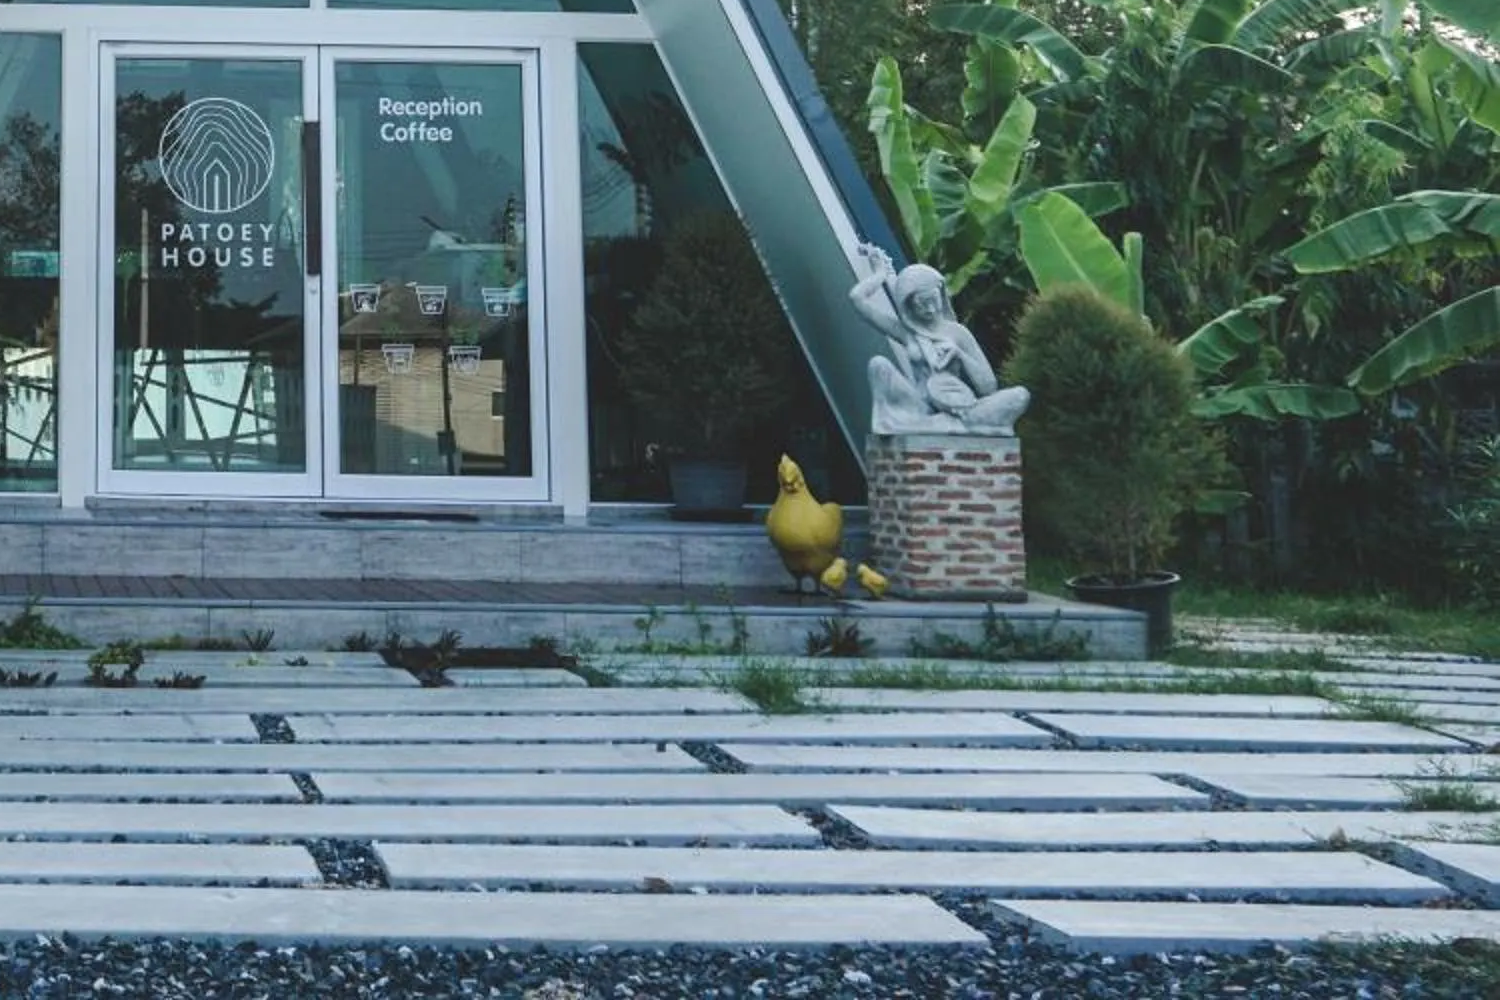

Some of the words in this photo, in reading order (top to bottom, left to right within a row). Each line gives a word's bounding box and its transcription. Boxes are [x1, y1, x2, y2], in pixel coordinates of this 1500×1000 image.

[378, 96, 484, 121] Reception
[380, 121, 453, 143] Coffee
[161, 222, 275, 242] PATOEY
[161, 246, 275, 267] HOUSE
